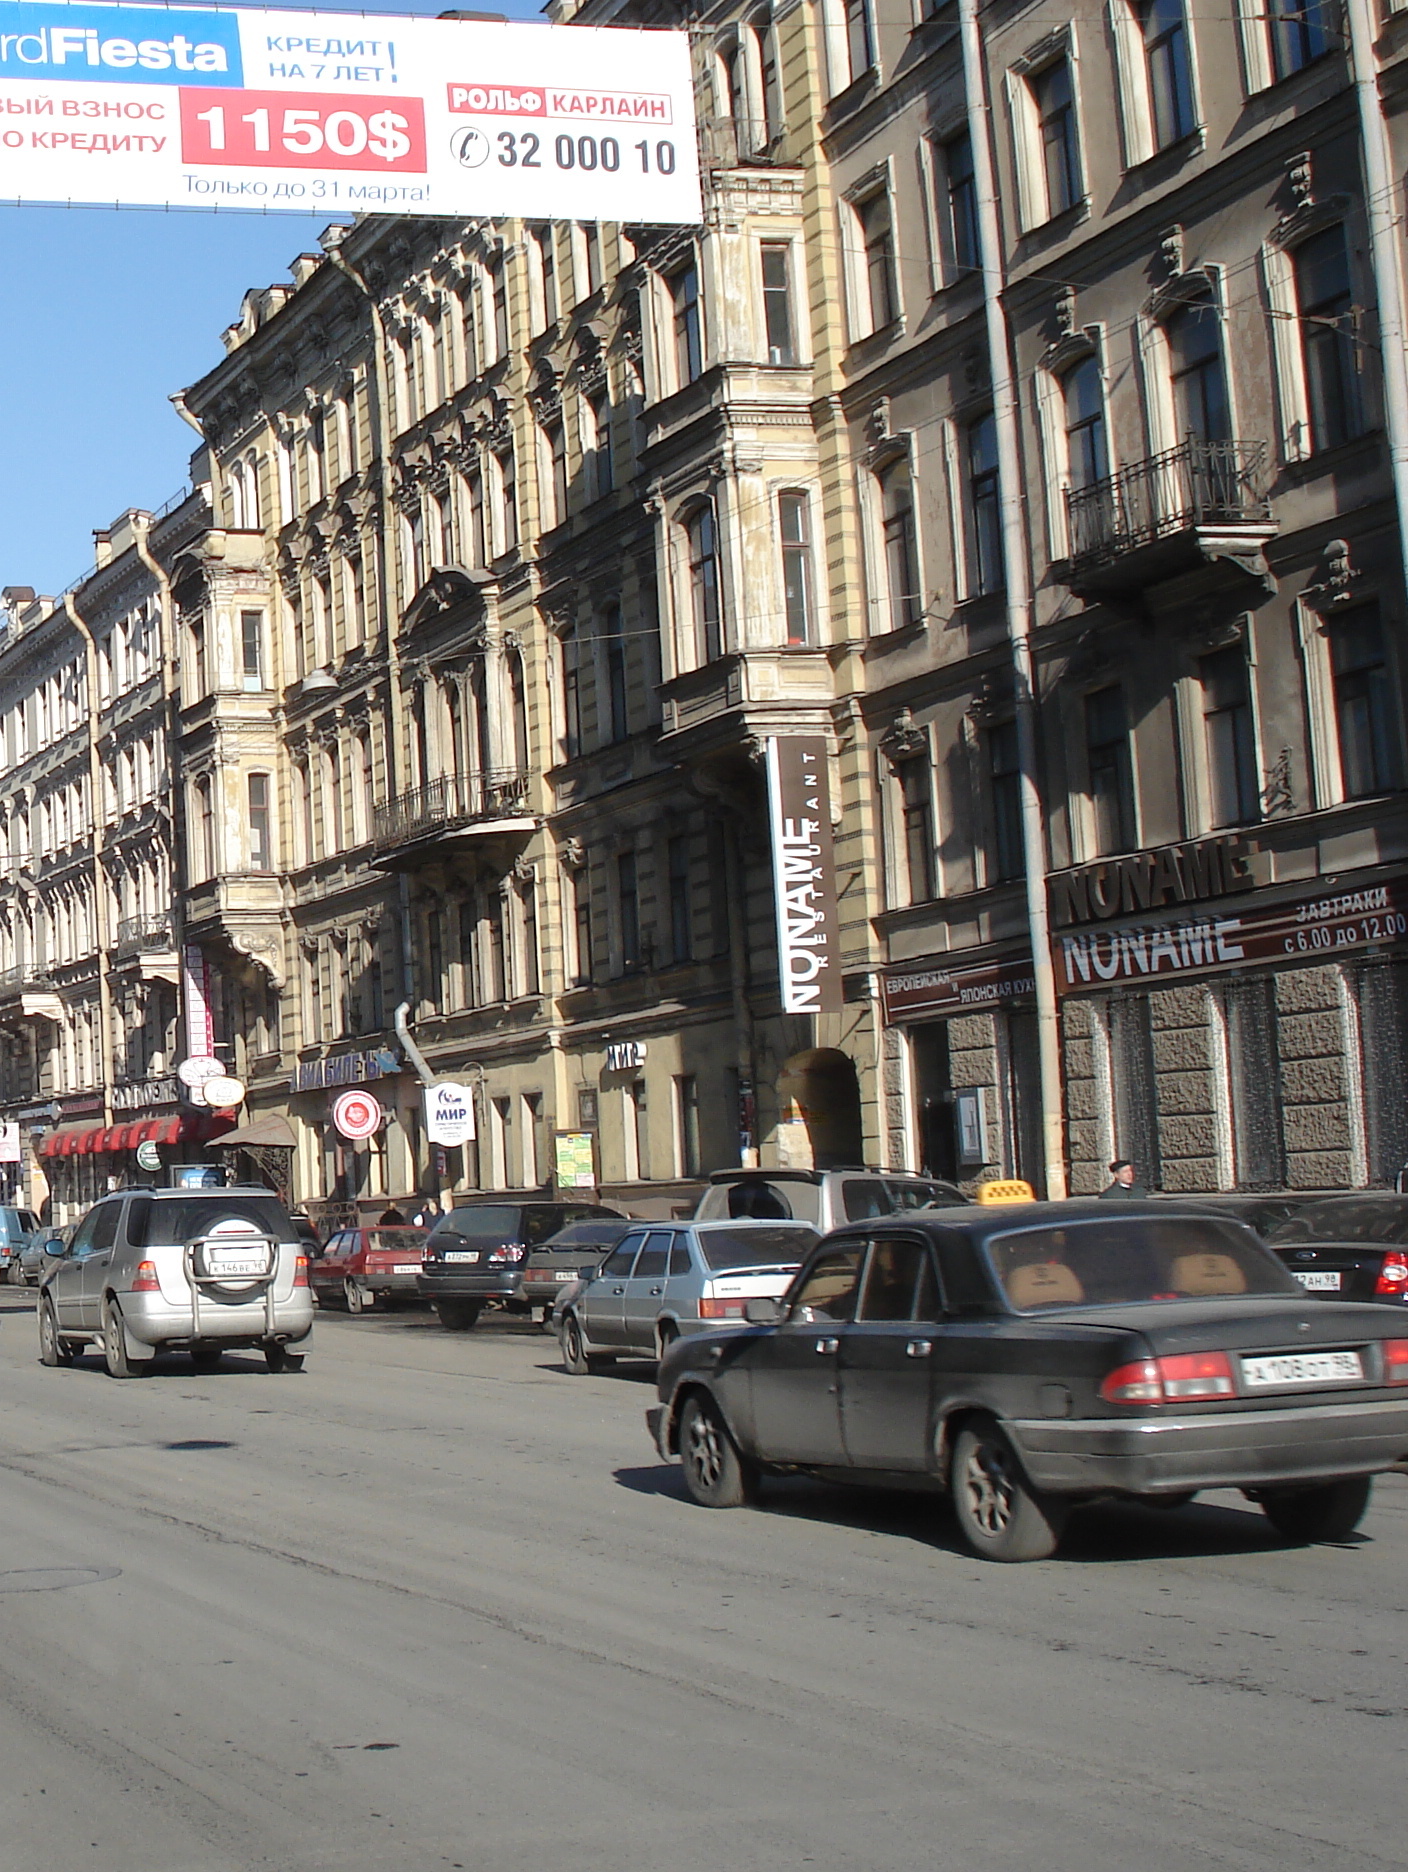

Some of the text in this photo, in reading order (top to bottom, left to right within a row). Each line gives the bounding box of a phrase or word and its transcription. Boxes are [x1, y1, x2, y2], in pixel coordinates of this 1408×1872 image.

[267, 36, 381, 58] КРЕДИТ
[269, 62, 306, 79] НА
[311, 64, 325, 80] 7
[63, 99, 166, 120] ВЗНОС
[452, 87, 541, 113] РОЛЬФ
[551, 92, 666, 119] КАРЛАЙН
[31, 131, 167, 155] КРЕДИТУ
[498, 131, 676, 175] 32 000 10
[182, 174, 431, 204] Только до 31 марта!
[785, 818, 821, 1014] NONAME
[1296, 887, 1388, 922] ЗАВТРАКИ
[1297, 927, 1331, 951] 6.00
[1336, 928, 1357, 947] до
[1361, 913, 1407, 940] 12.00
[1062, 919, 1245, 984] NONAME
[960, 982, 1012, 1003] ЯПОНСКАЯ
[435, 1108, 467, 1121] МИР
